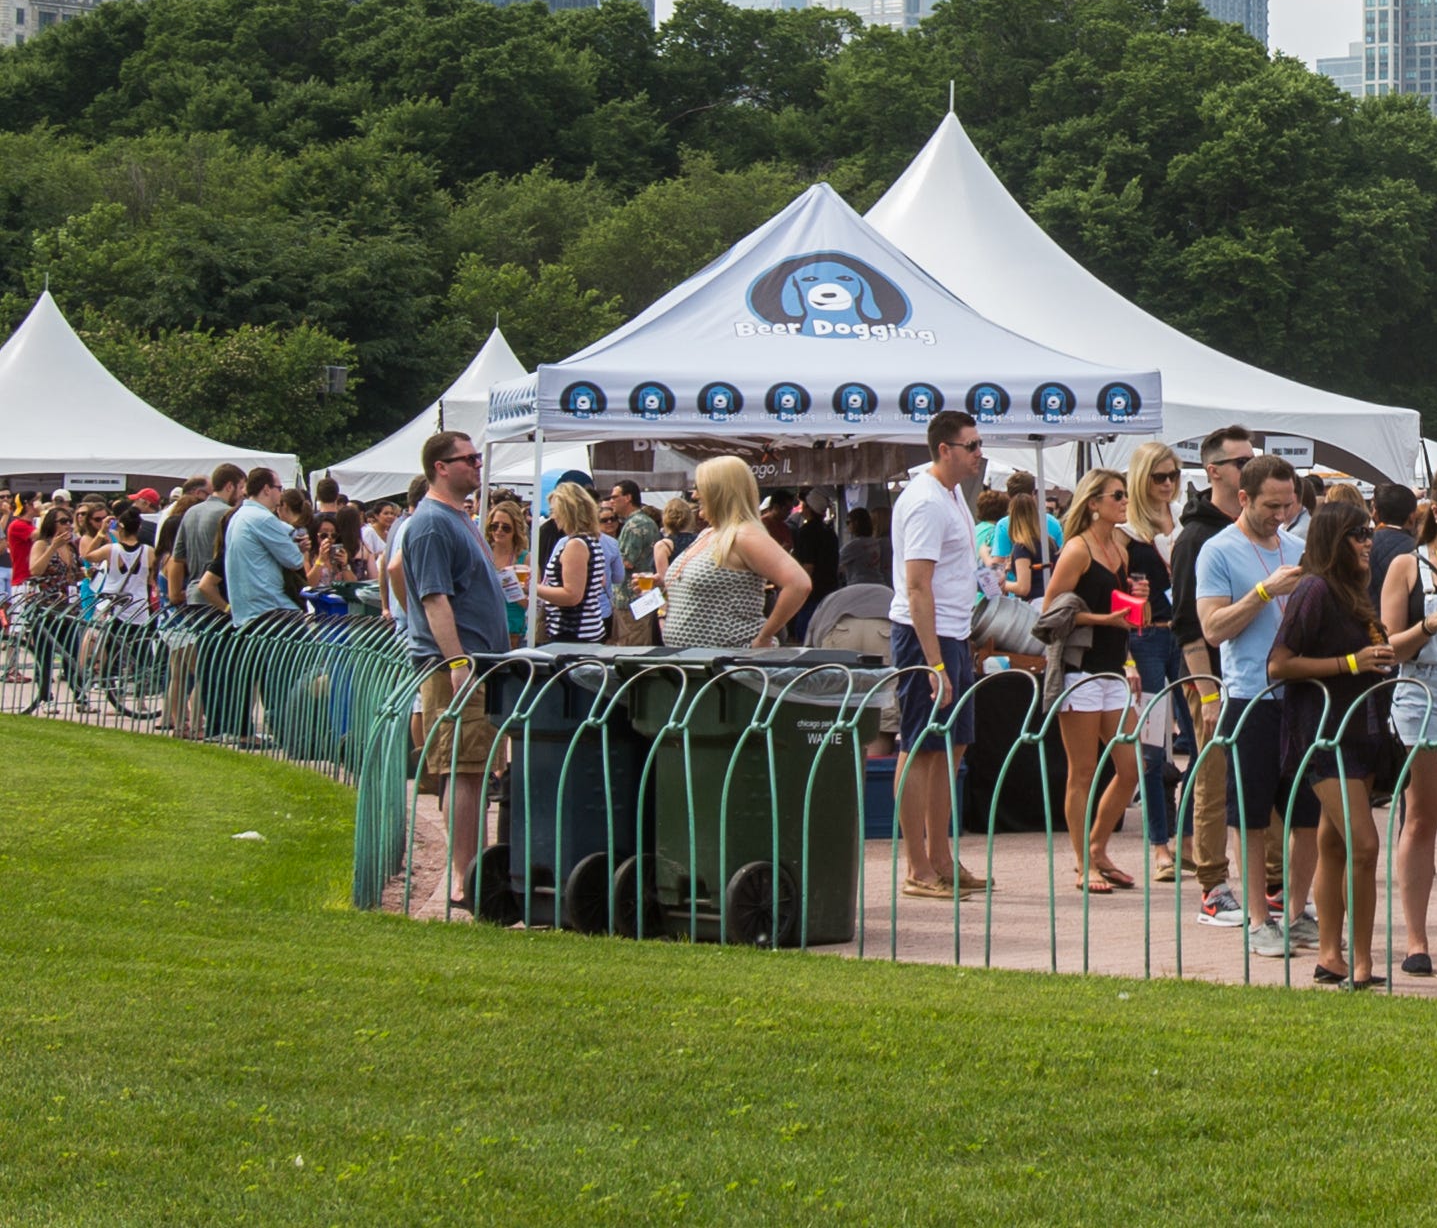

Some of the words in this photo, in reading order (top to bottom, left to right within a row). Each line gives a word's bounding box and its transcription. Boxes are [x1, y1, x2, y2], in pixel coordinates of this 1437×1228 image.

[735, 322, 801, 337] Beer
[812, 319, 936, 345] Dogging
[807, 732, 842, 744] WATE
